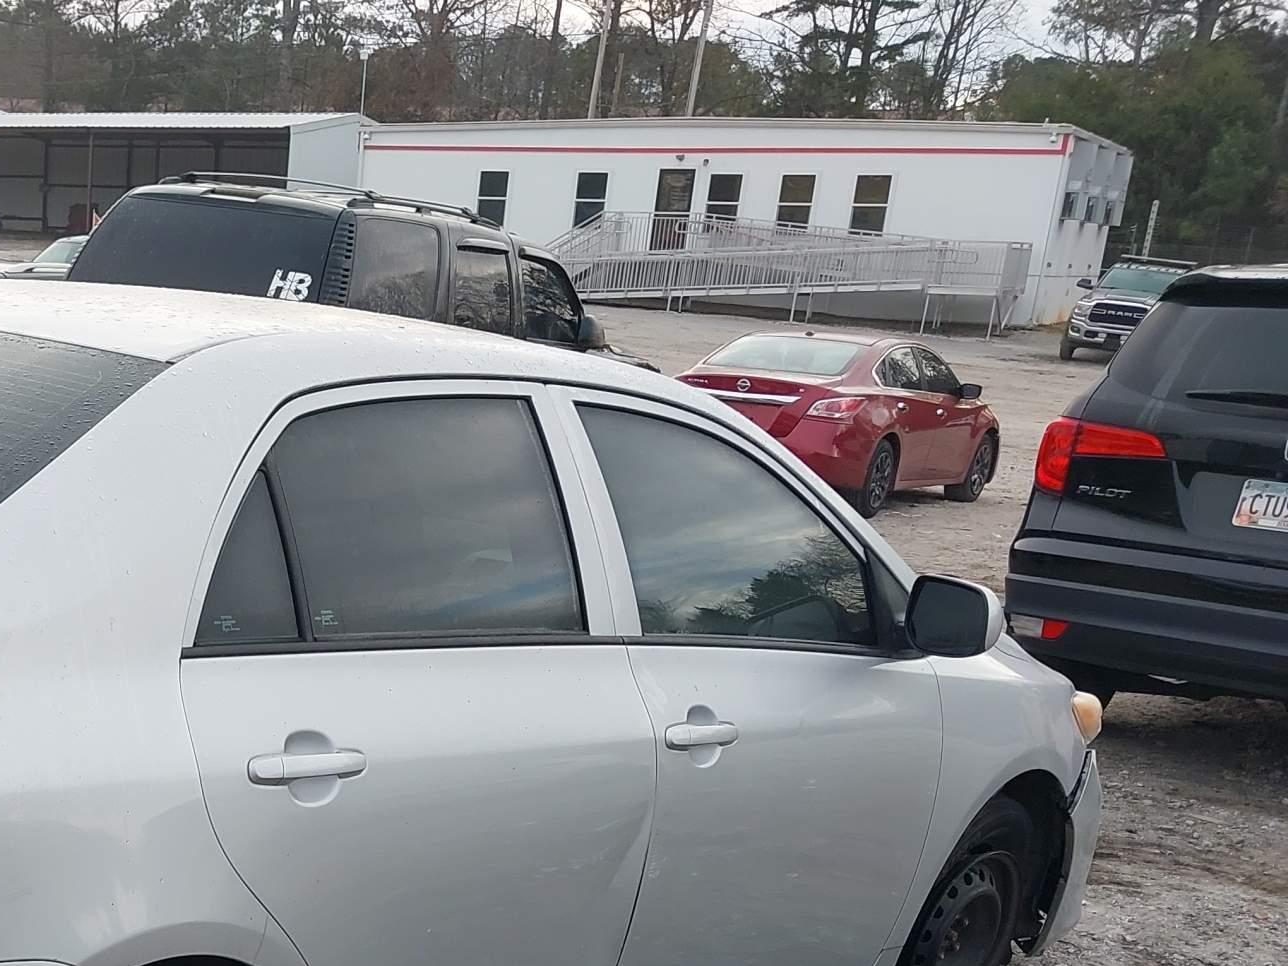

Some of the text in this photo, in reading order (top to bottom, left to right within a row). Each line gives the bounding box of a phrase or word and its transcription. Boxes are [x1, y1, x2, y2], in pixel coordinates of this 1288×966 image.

[266, 268, 312, 300] HB
[1076, 485, 1132, 498] PILOT
[1249, 493, 1288, 518] CTU
